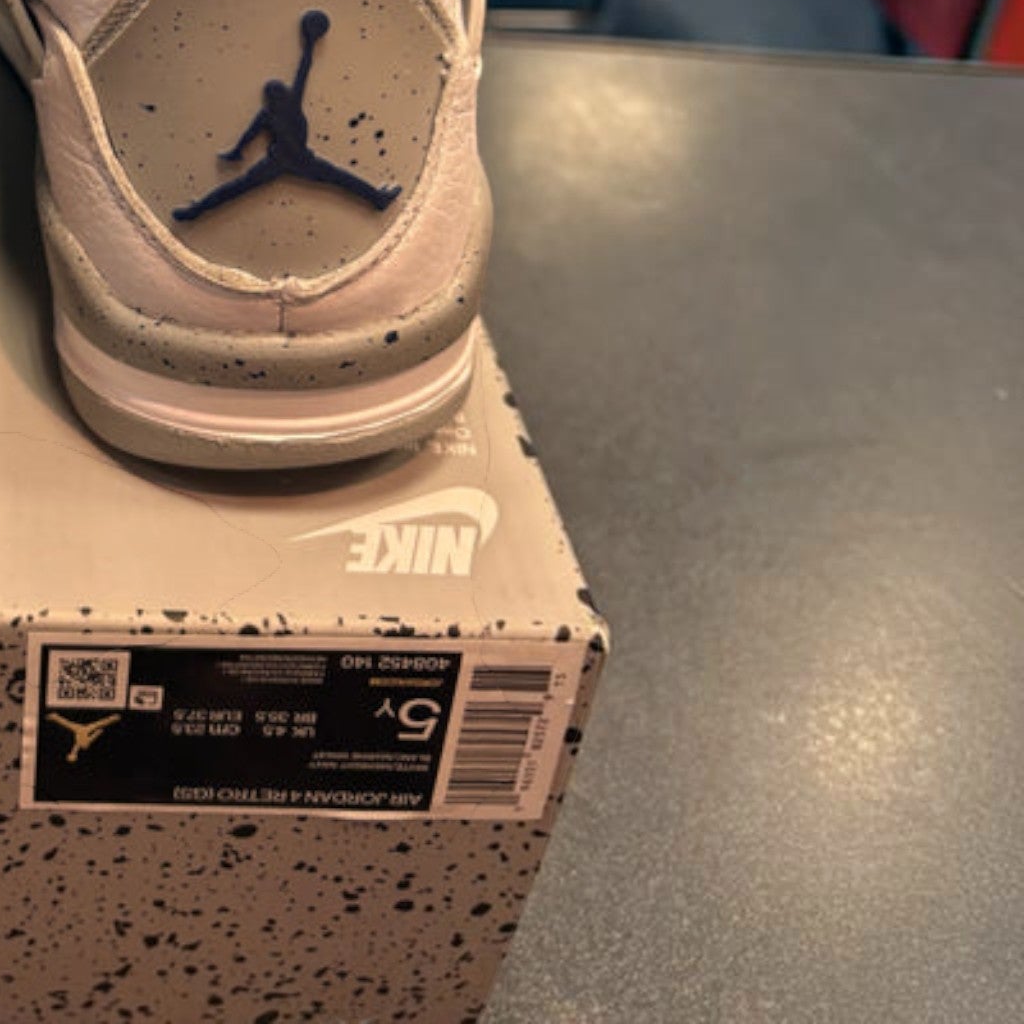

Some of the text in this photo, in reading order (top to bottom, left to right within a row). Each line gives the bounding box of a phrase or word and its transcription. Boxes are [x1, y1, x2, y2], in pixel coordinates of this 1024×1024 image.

[345, 524, 478, 576] NIKE
[216, 787, 289, 803] RETRO
[290, 790, 303, 803] 4
[304, 789, 388, 806] JORDAN
[390, 792, 423, 806] AIR
